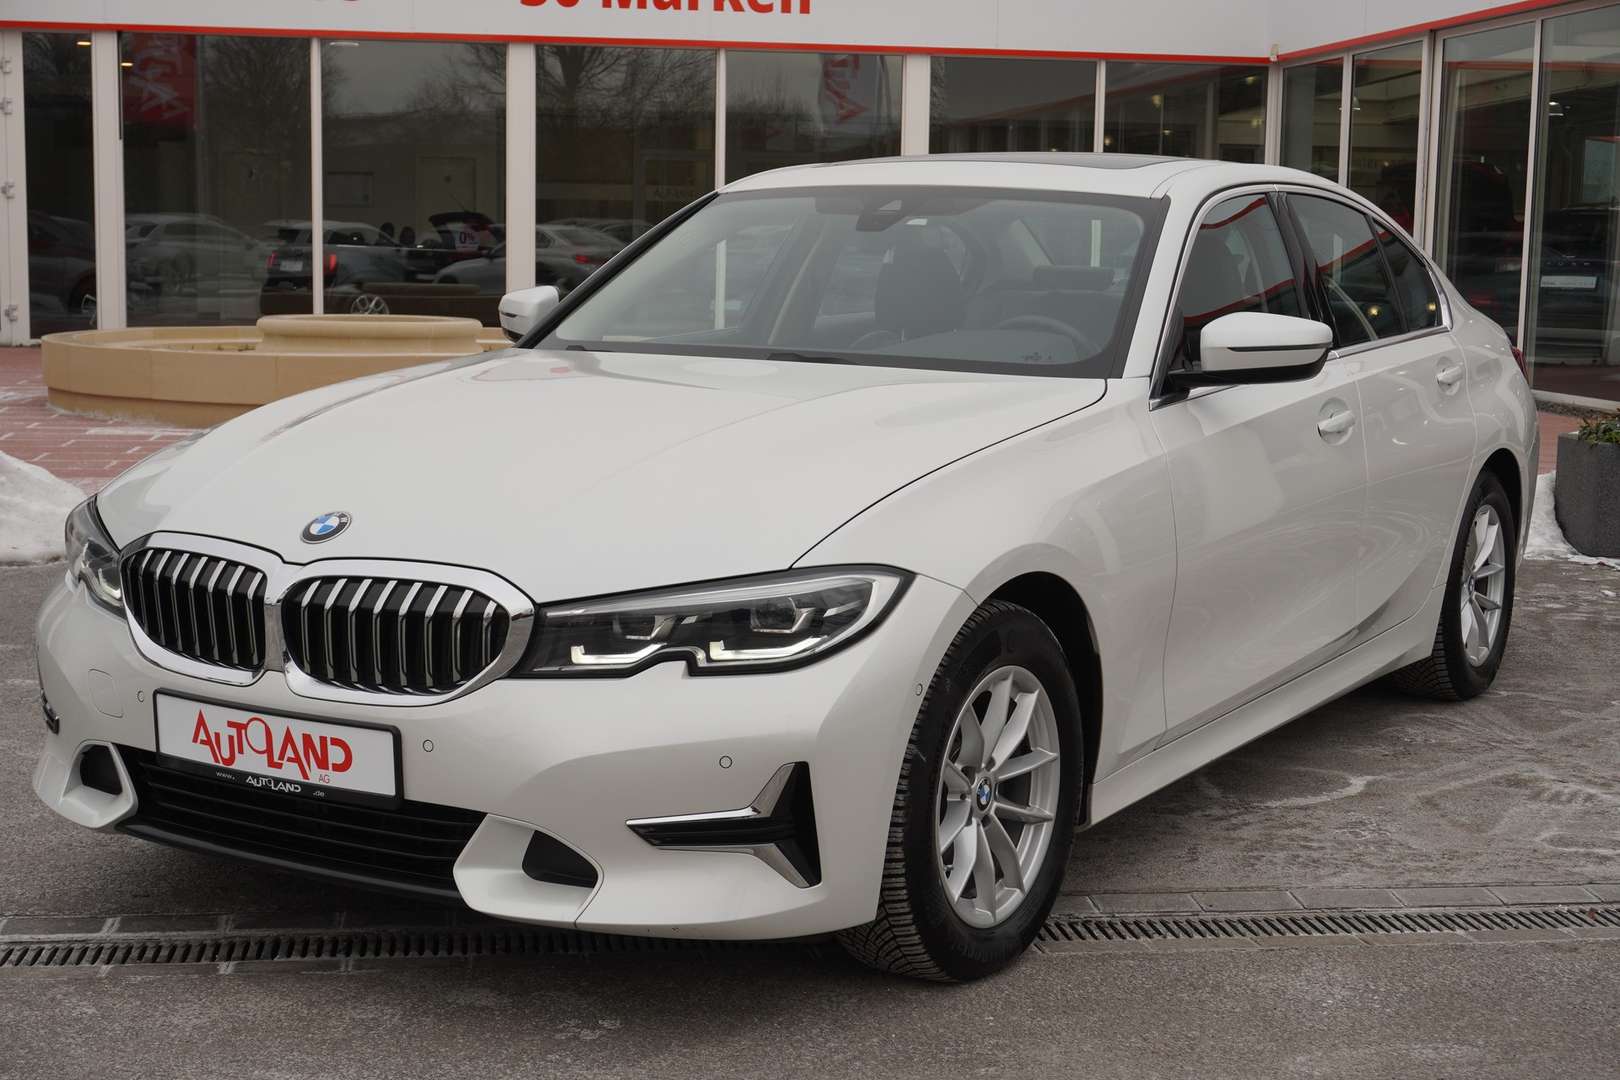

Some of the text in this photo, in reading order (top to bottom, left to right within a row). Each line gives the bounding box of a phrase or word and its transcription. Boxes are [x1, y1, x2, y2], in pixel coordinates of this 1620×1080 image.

[192, 710, 353, 781] AUTOLAND
[246, 776, 301, 792] AUTOLAND
[318, 773, 330, 784] AG
